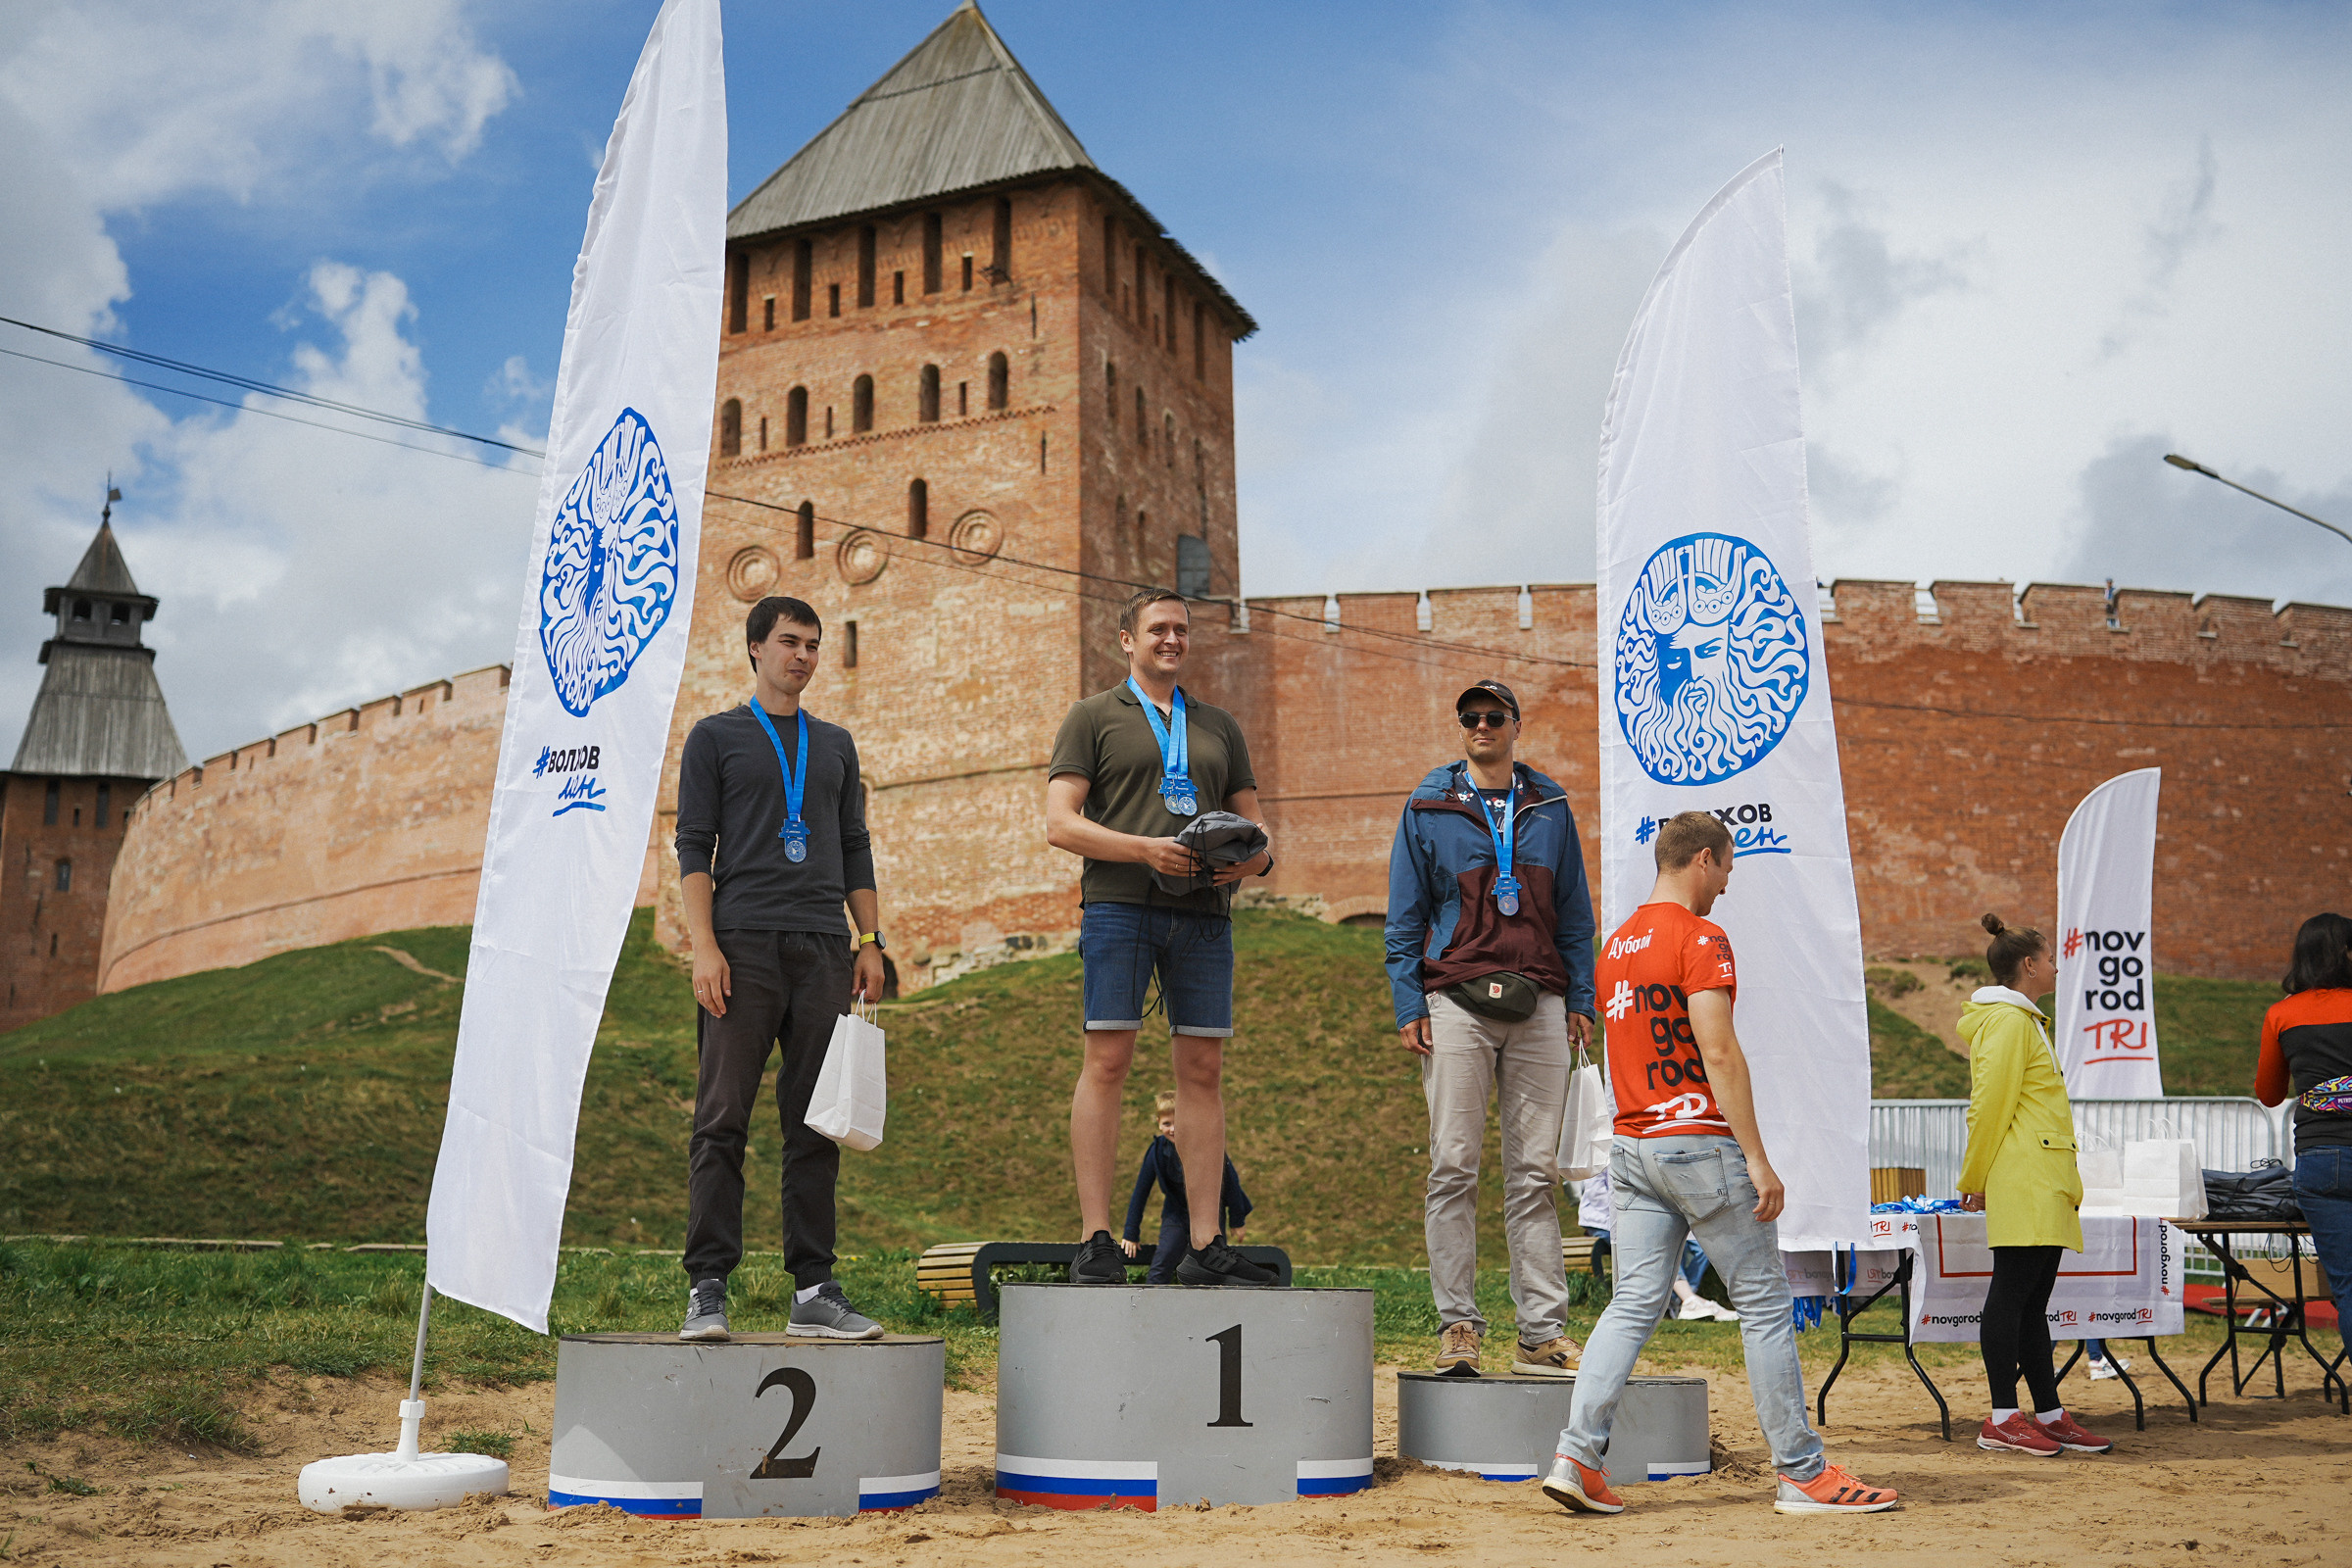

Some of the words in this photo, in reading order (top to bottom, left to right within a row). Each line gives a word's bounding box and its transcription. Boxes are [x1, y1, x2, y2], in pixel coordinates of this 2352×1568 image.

[1734, 825, 1788, 849] ен
[2063, 927, 2146, 960] #nov
[2098, 956, 2144, 987] go
[2084, 978, 2145, 1011] rod
[1649, 1015, 1693, 1057] go
[2083, 1018, 2148, 1050] TRI
[2087, 1307, 2153, 1324] #novgorodTRI
[1204, 1323, 1253, 1428] 1
[750, 1367, 821, 1480] 2
